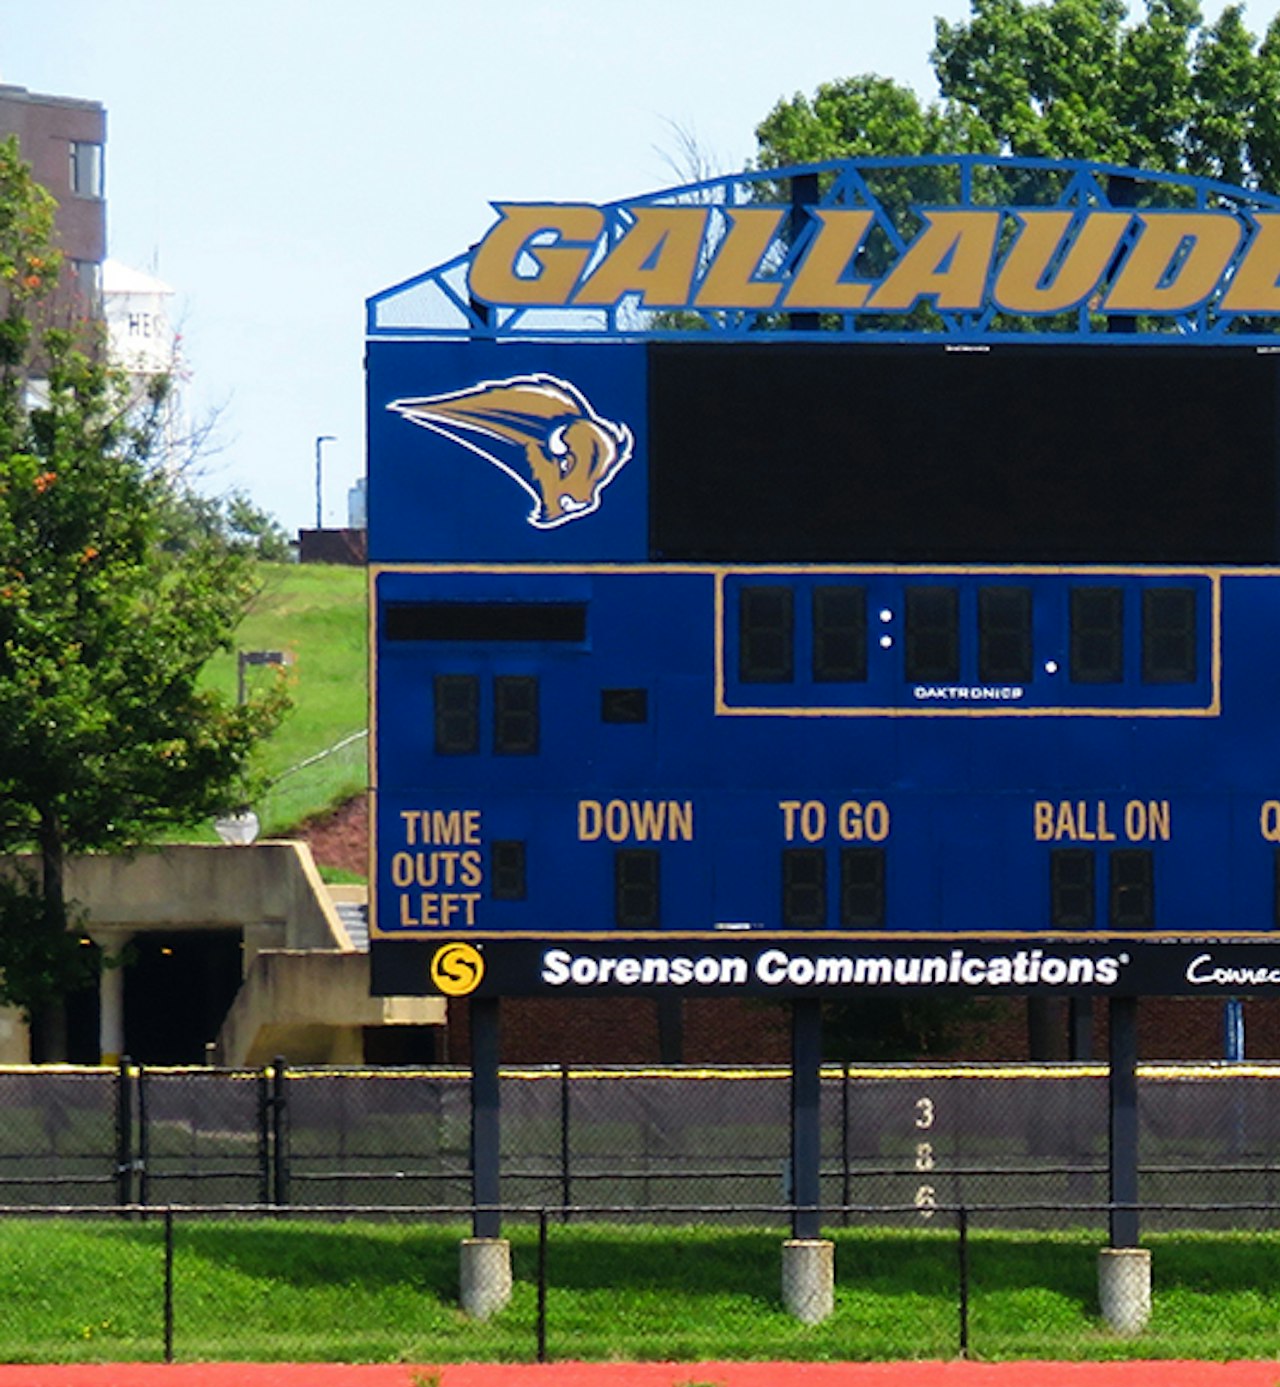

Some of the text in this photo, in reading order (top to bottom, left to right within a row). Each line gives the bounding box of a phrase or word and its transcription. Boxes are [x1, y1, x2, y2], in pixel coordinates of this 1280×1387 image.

[400, 810, 482, 846] TIME
[577, 799, 694, 843] DOWN
[778, 800, 890, 843] TO GO
[1033, 799, 1171, 842] BALL ON
[392, 850, 482, 887] OUTS
[400, 893, 481, 926] LEFT
[541, 949, 1120, 985] Sorenson Communications
